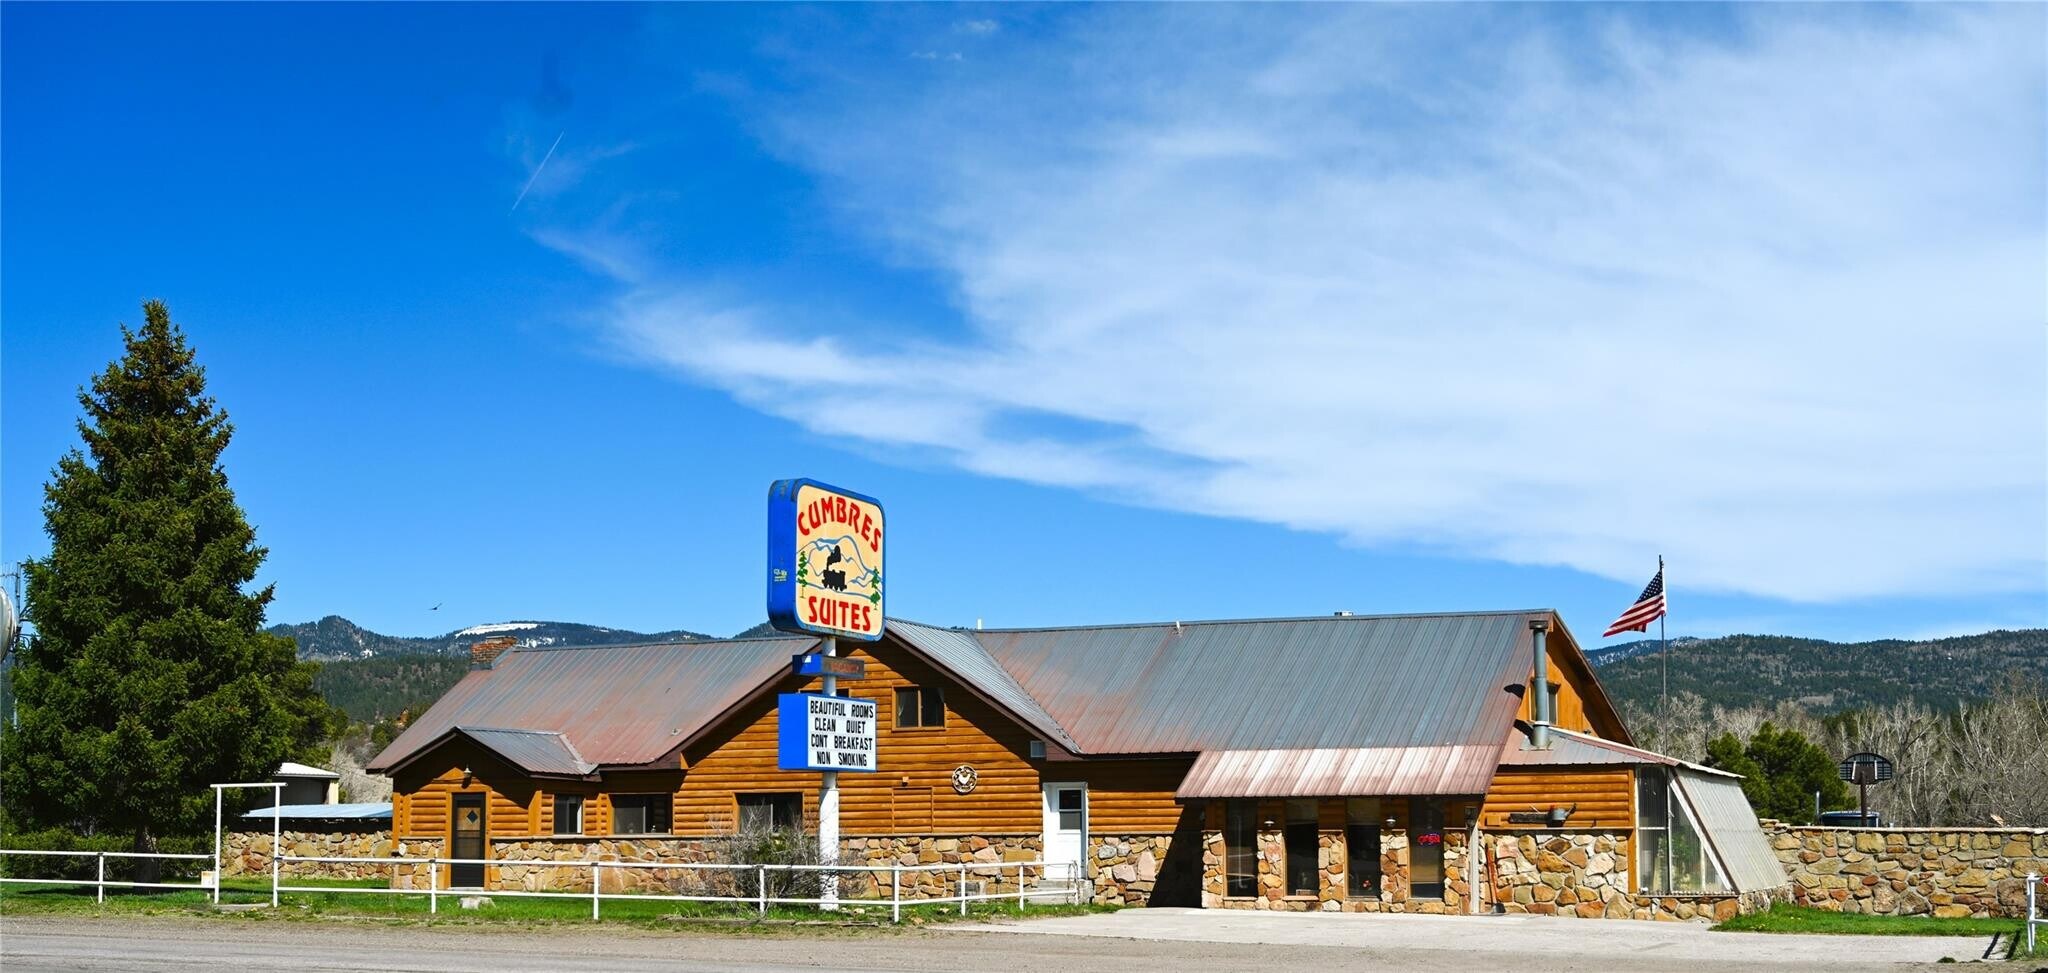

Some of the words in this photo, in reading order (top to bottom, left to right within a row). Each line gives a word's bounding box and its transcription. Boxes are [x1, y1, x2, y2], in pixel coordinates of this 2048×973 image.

[798, 496, 881, 552] CUMBRES
[808, 596, 871, 632] SUITES
[810, 700, 846, 716] BEAUTIFUL
[851, 704, 874, 718] ROOMS
[814, 717, 836, 732] CLEAN
[846, 720, 866, 734] QUIET
[811, 733, 828, 748] CONT
[834, 735, 873, 750] BREAKFAST
[816, 751, 831, 764] NON
[838, 752, 867, 766] SMOKING
